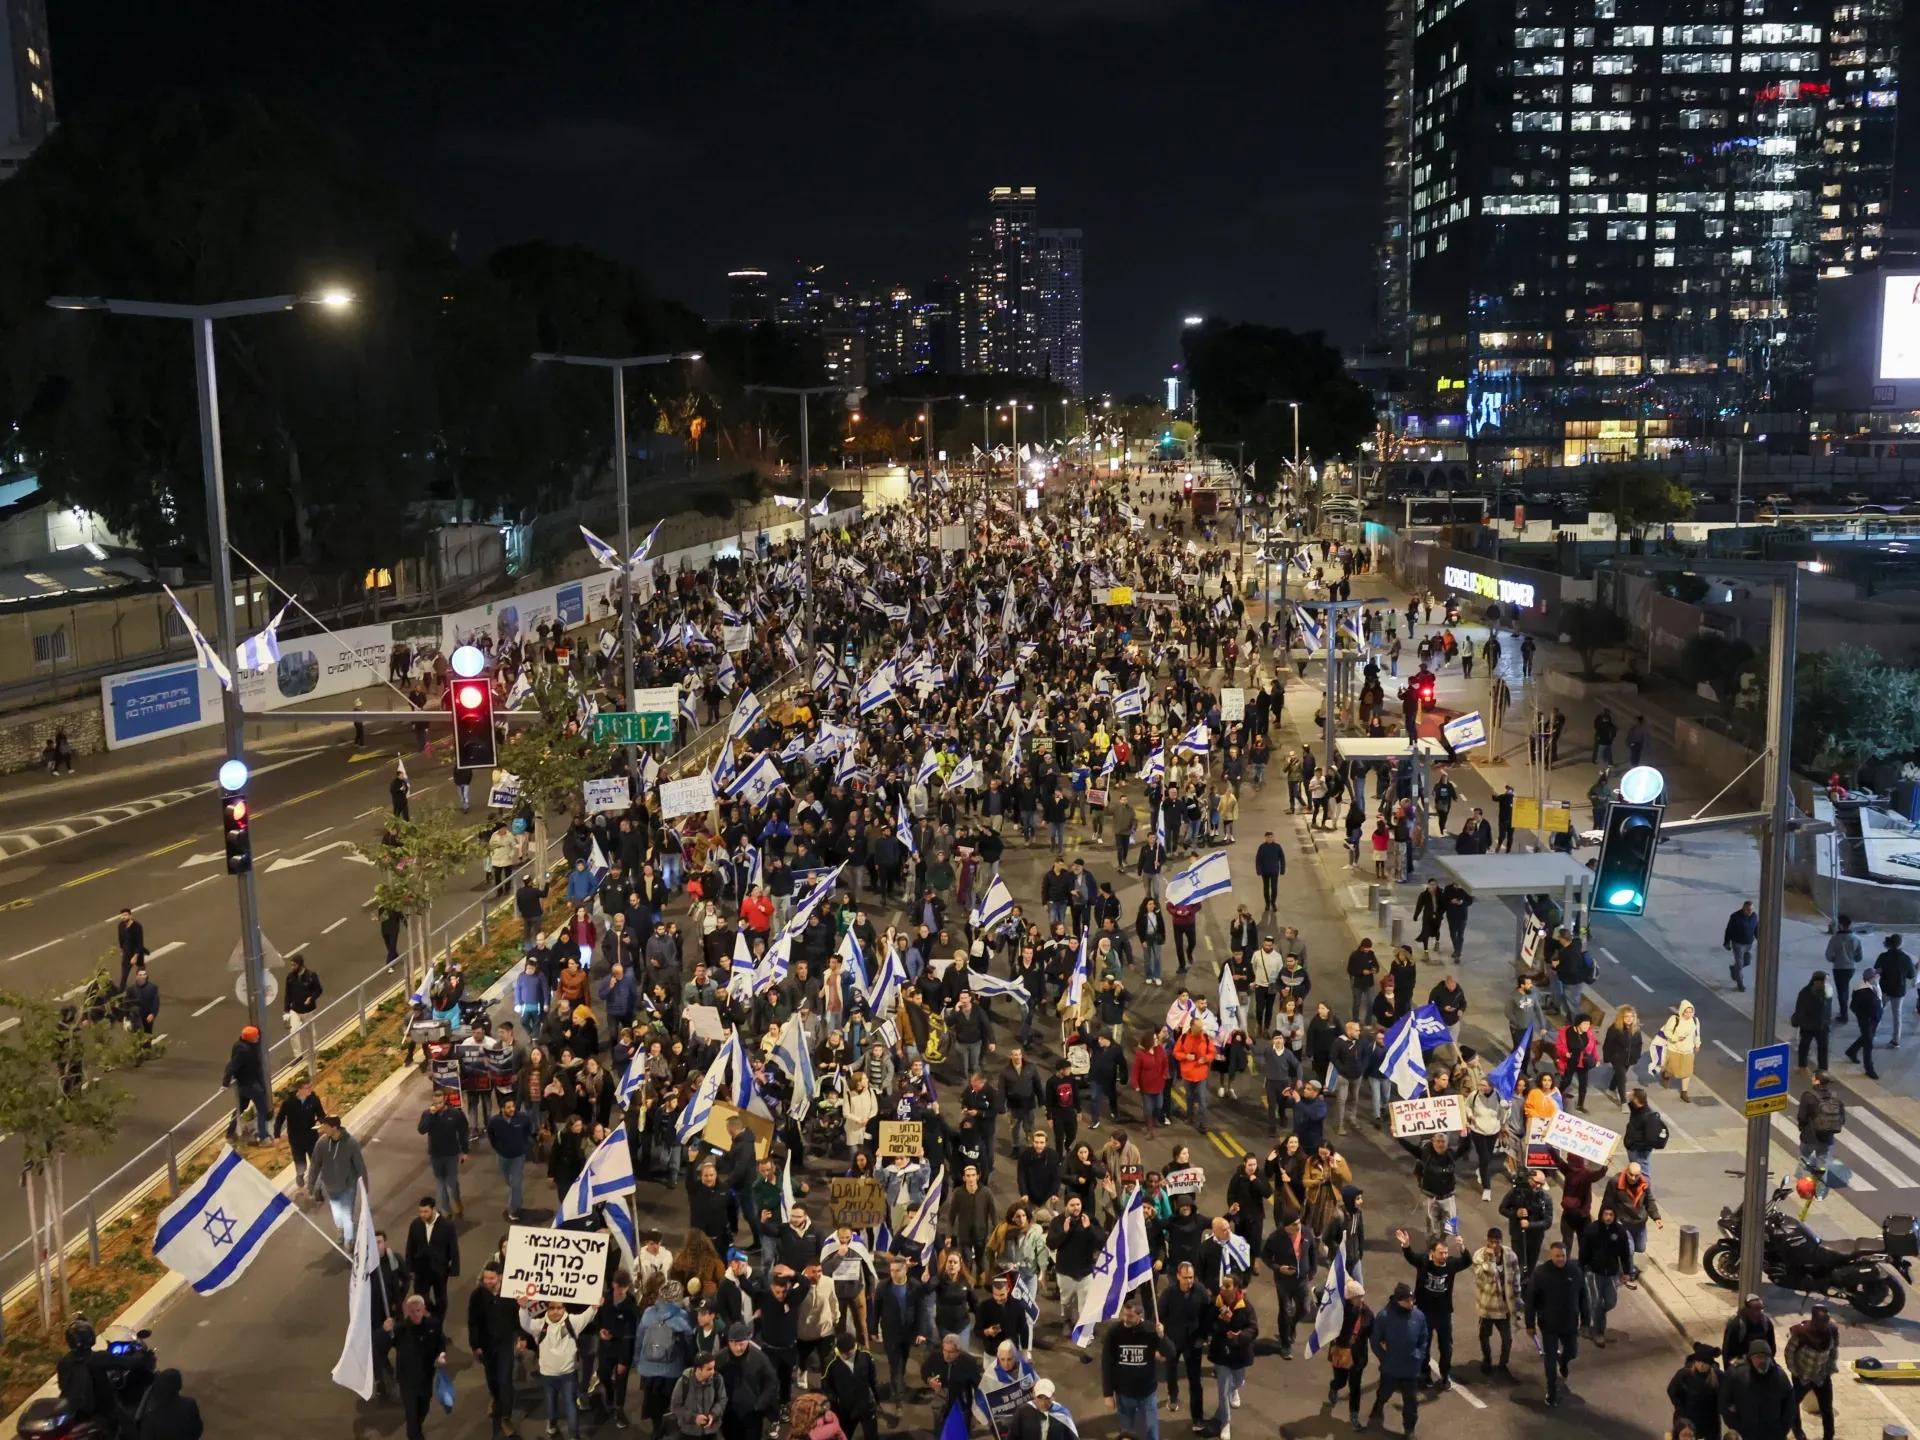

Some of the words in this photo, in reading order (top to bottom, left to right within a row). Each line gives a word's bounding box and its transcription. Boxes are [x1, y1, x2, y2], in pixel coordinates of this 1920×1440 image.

[1499, 580, 1535, 607] TOWER
[1433, 1098, 1456, 1108] בואו
[1404, 1110, 1432, 1121] אחים
[1557, 1113, 1583, 1127] חינם
[1402, 1117, 1448, 1133] אנחנו
[1555, 1123, 1573, 1135] לנו
[524, 1234, 570, 1249] מוצא:
[572, 1239, 605, 1254] ארץ
[533, 1252, 584, 1270] מרוקו
[509, 1268, 554, 1283] להיות
[560, 1271, 598, 1285] סיכוי
[1122, 1348, 1144, 1356] אזרח
[1130, 1355, 1144, 1363] סוג
